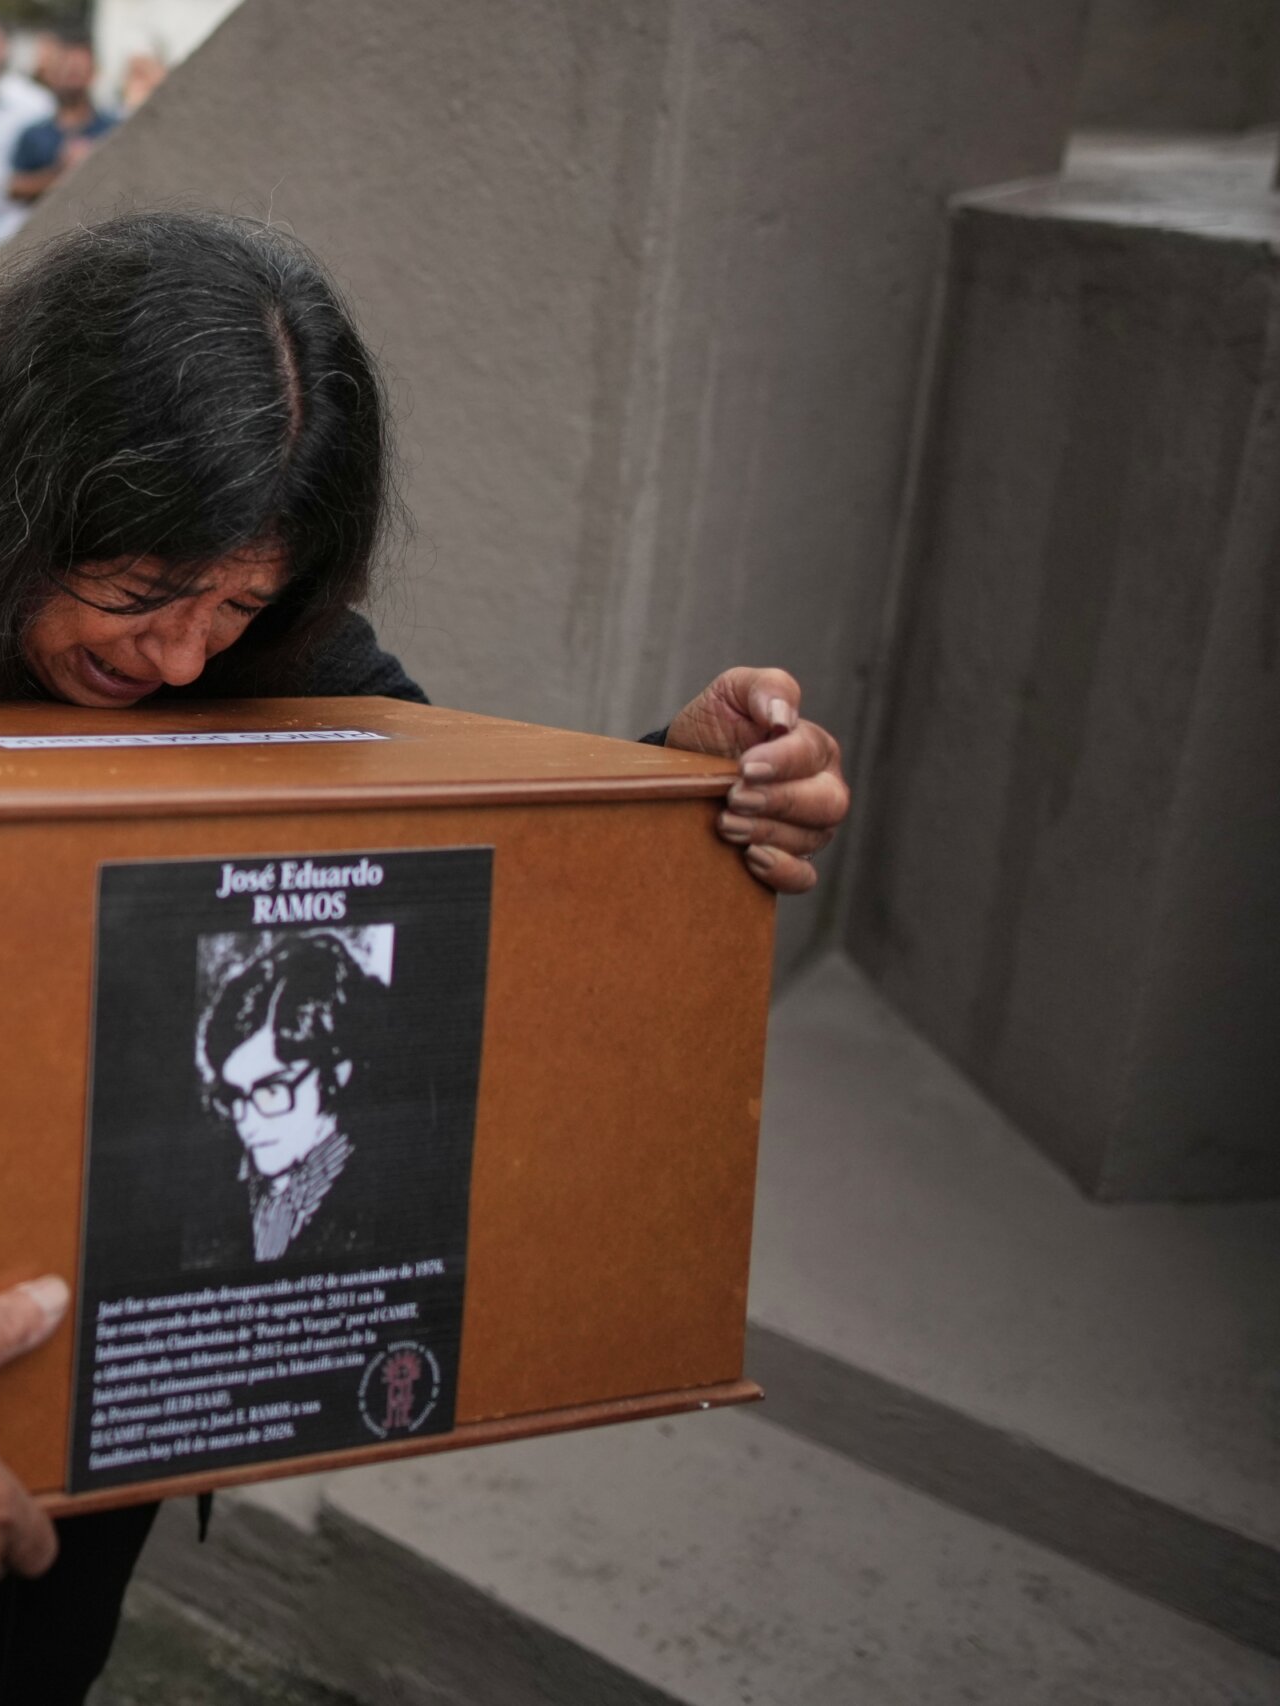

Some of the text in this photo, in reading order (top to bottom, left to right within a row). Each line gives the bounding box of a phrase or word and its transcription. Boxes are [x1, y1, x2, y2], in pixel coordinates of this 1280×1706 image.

[216, 857, 384, 898] José Eduardo
[252, 891, 347, 924] RAMOS
